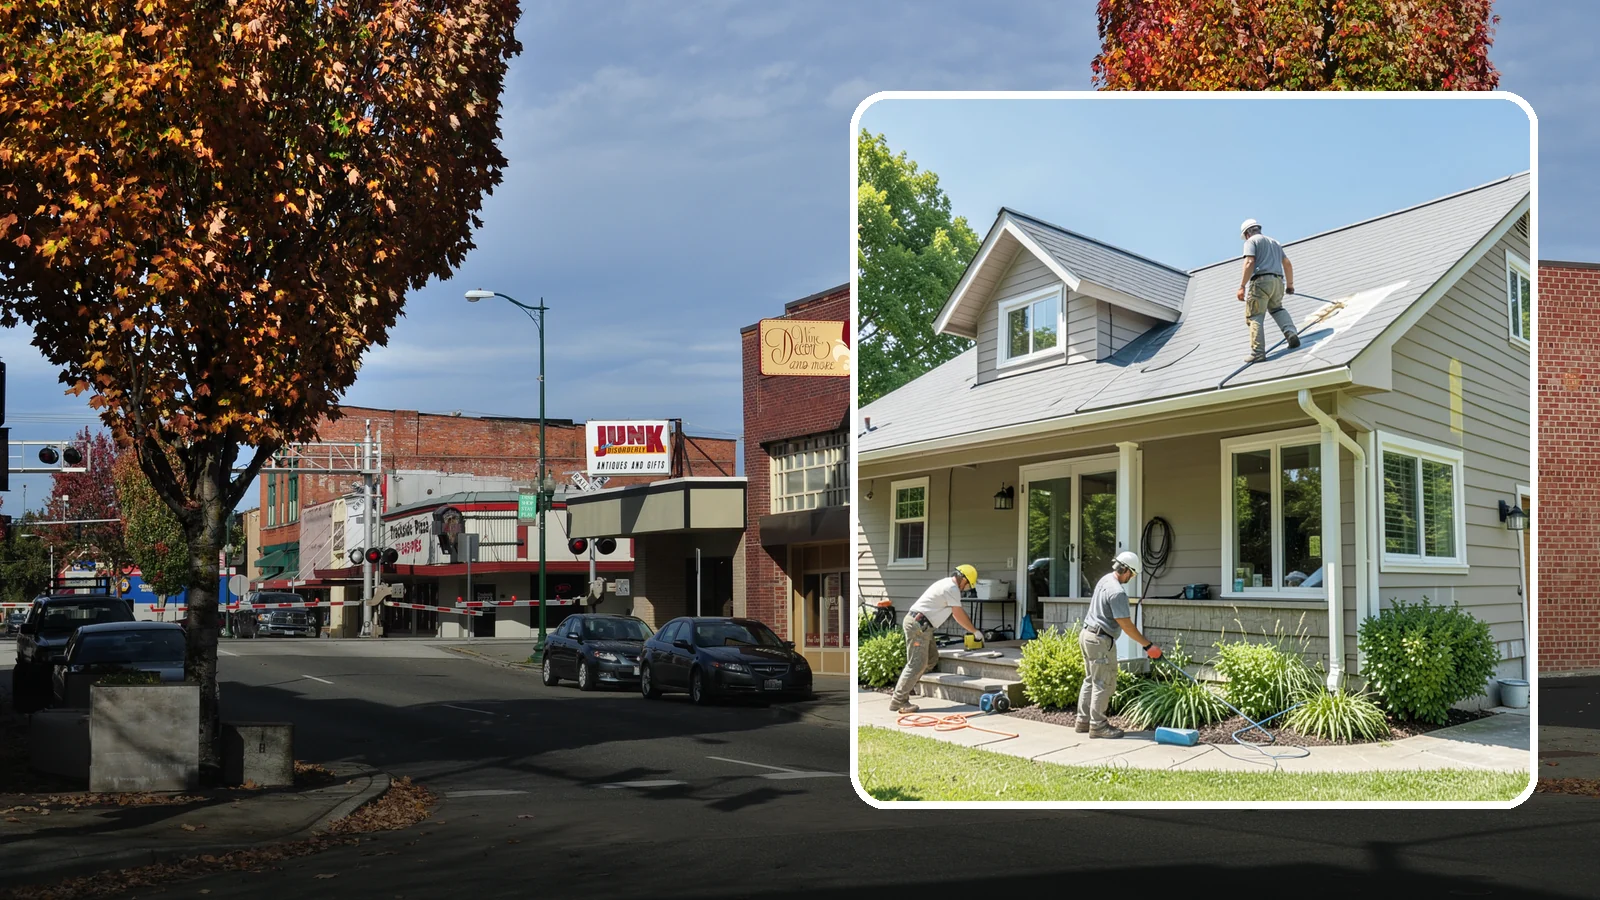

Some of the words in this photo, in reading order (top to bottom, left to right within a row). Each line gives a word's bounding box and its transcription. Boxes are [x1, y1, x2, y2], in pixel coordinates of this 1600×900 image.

[765, 328, 831, 365] Decor
[595, 425, 665, 457] JUNK
[607, 446, 646, 454] DISORDERLY
[597, 461, 628, 470] ANTIQUES
[631, 461, 644, 470] AND
[647, 460, 665, 470] GIFTS
[390, 521, 413, 540] Trackside
[414, 519, 429, 535] Pizza
